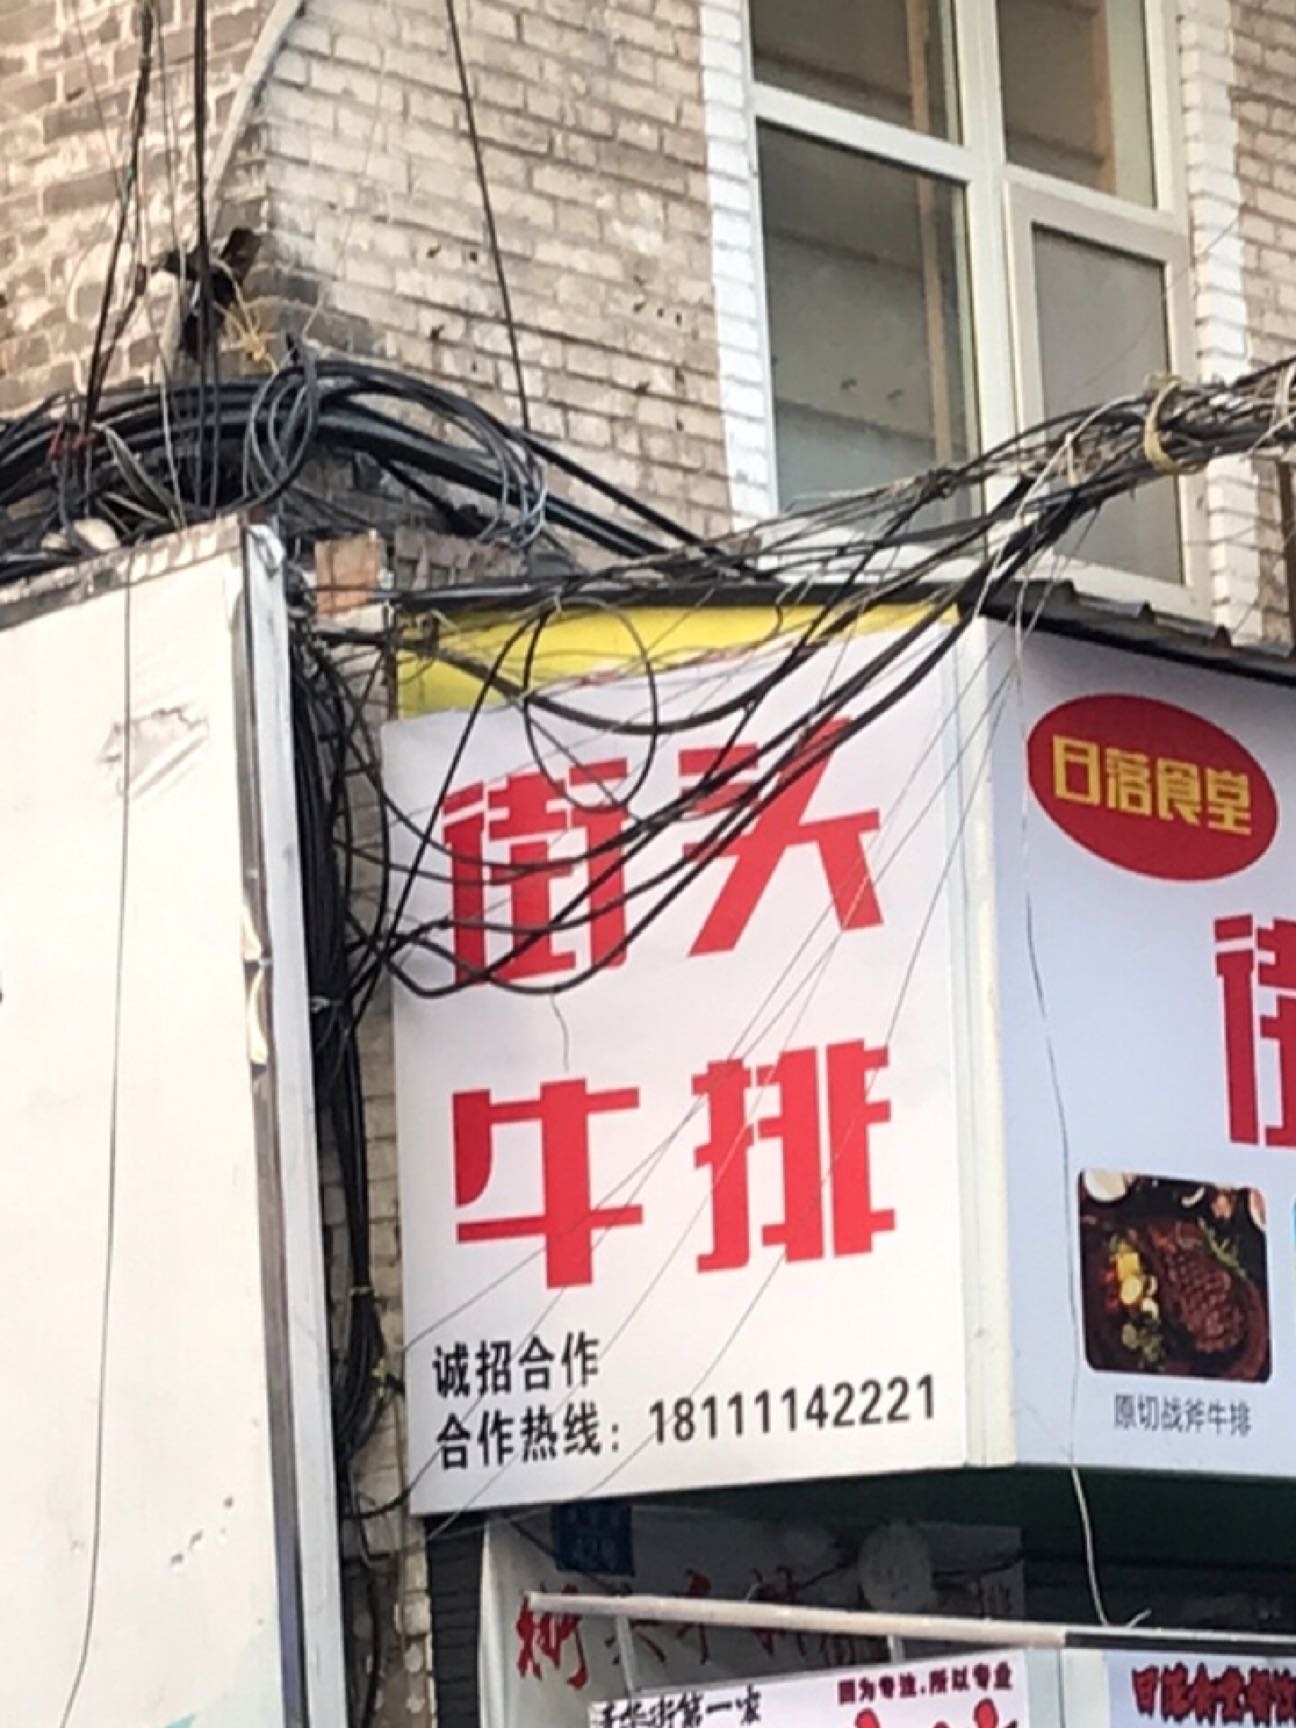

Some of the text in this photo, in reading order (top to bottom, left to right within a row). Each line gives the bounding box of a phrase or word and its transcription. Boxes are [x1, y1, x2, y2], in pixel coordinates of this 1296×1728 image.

[1052, 735, 1252, 836] 日落食堂
[451, 1038, 896, 1290] 牛排
[432, 1332, 602, 1400] 诚招合作
[1114, 1393, 1253, 1437] 原切战斧牛排
